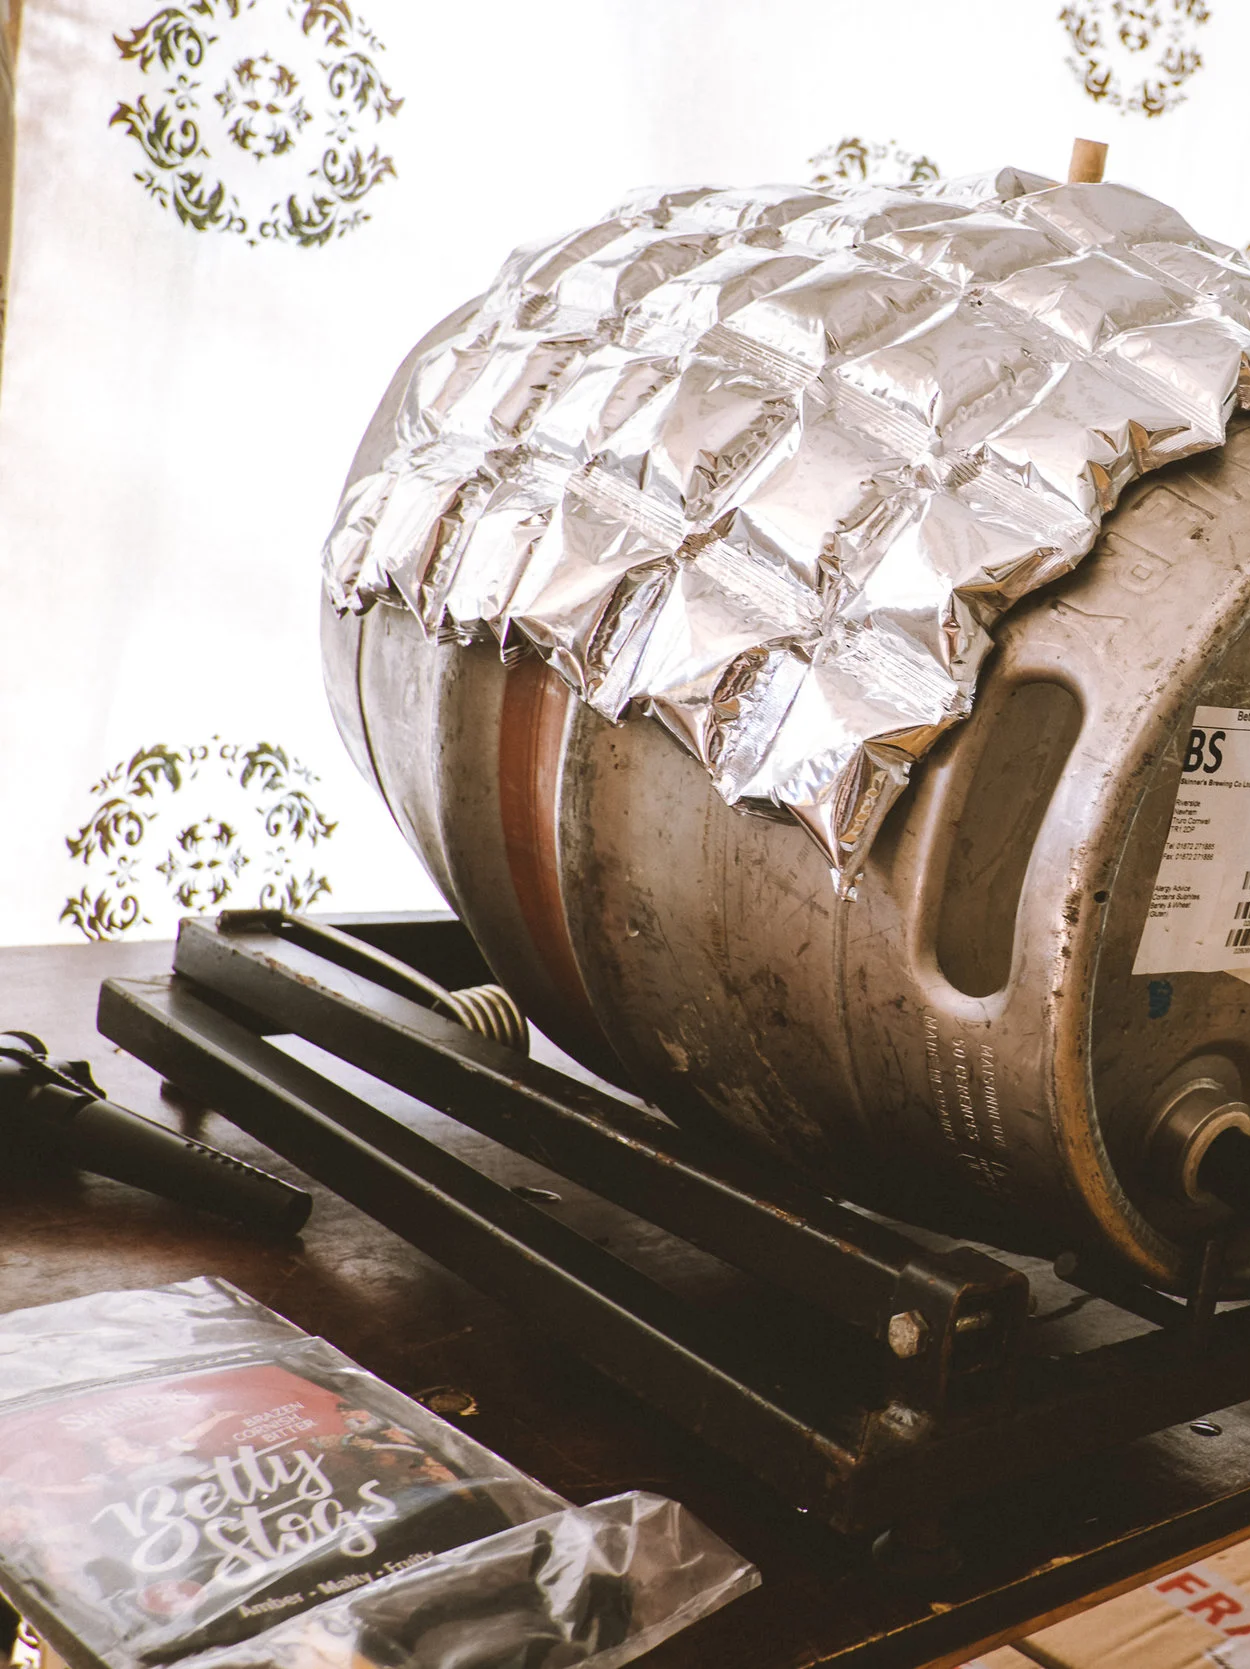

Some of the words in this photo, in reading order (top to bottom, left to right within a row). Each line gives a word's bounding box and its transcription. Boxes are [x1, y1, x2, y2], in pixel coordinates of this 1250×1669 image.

[1182, 729, 1226, 774] BS
[1180, 778, 1207, 786] Skinner's
[1208, 779, 1233, 788] Brewing
[1234, 780, 1242, 788] Co
[1172, 816, 1187, 824] Truro
[924, 1015, 940, 1060] MADE
[928, 1067, 942, 1084] IN
[232, 1413, 301, 1441] CORNISH
[242, 1401, 305, 1427] BRAZEN
[261, 1418, 317, 1443] BITTER
[92, 1437, 333, 1573] Betty
[204, 1479, 399, 1586] Stogs
[238, 1592, 304, 1618] Amber
[316, 1572, 373, 1595] Malty
[382, 1551, 434, 1574] Fruity
